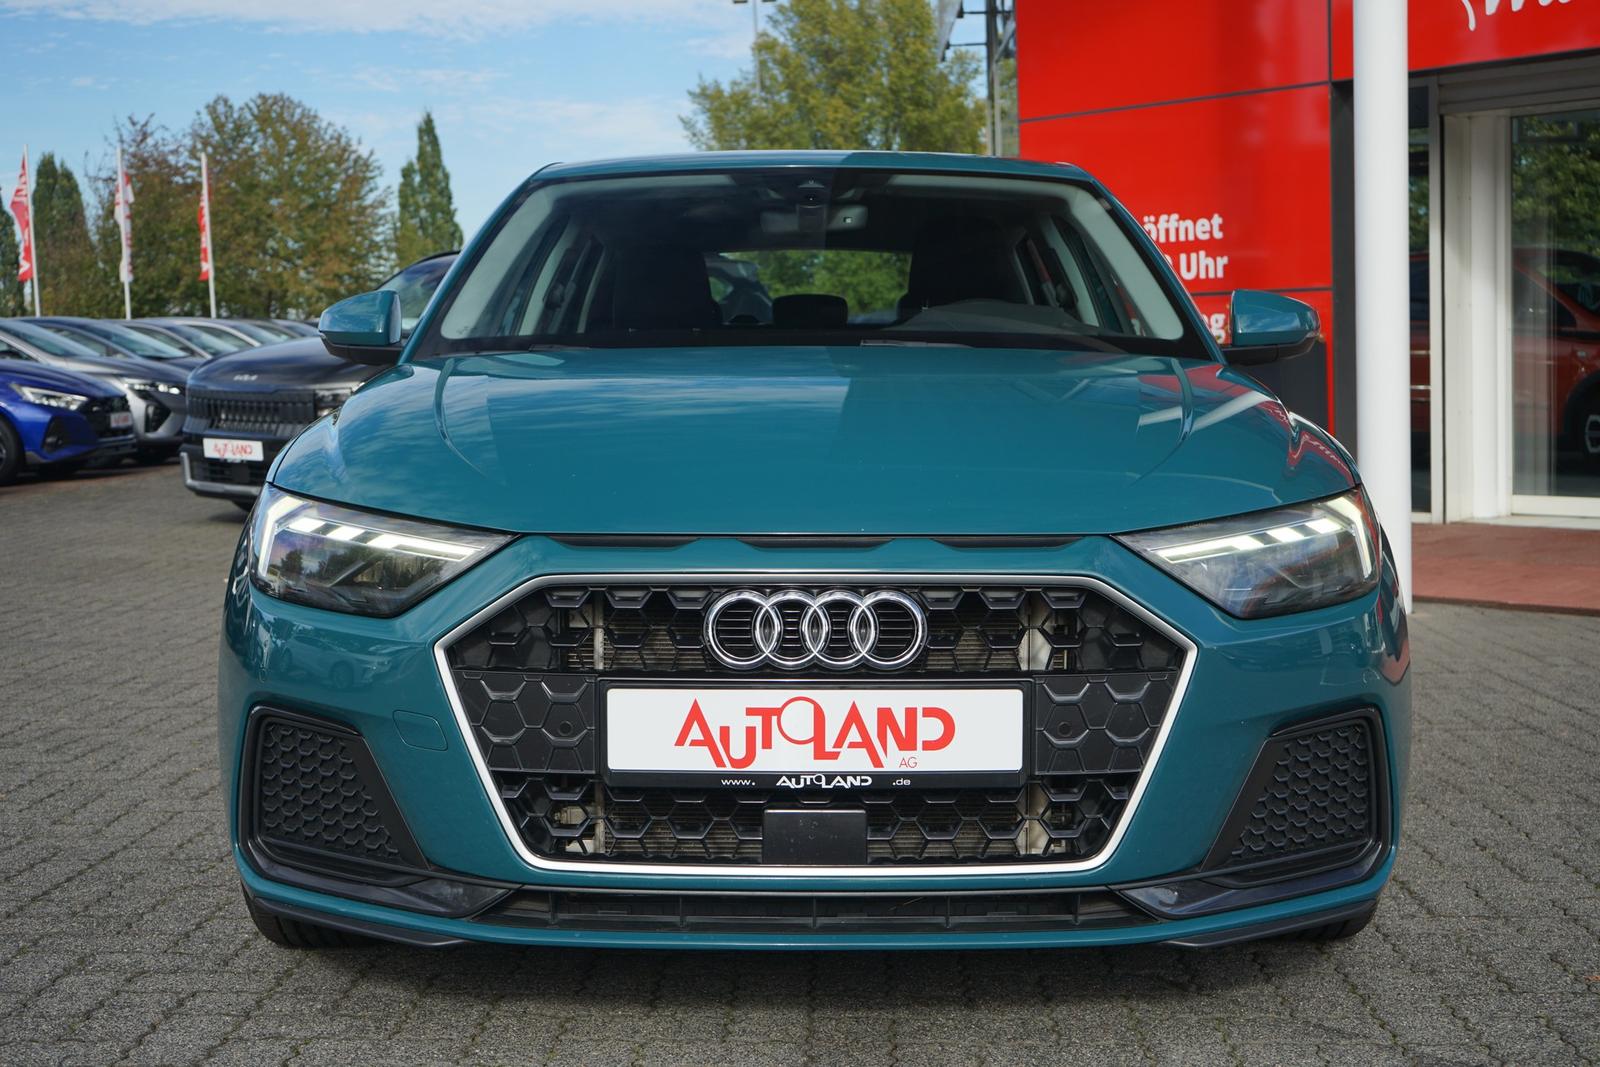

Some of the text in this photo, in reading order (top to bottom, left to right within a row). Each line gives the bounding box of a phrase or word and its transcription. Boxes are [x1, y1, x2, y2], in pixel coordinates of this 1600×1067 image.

[1180, 250, 1229, 281] Uhr
[674, 696, 956, 769] AUTOLAND
[898, 757, 918, 769] AG
[775, 773, 873, 790] AUTOLAND
[892, 777, 912, 786] .de
